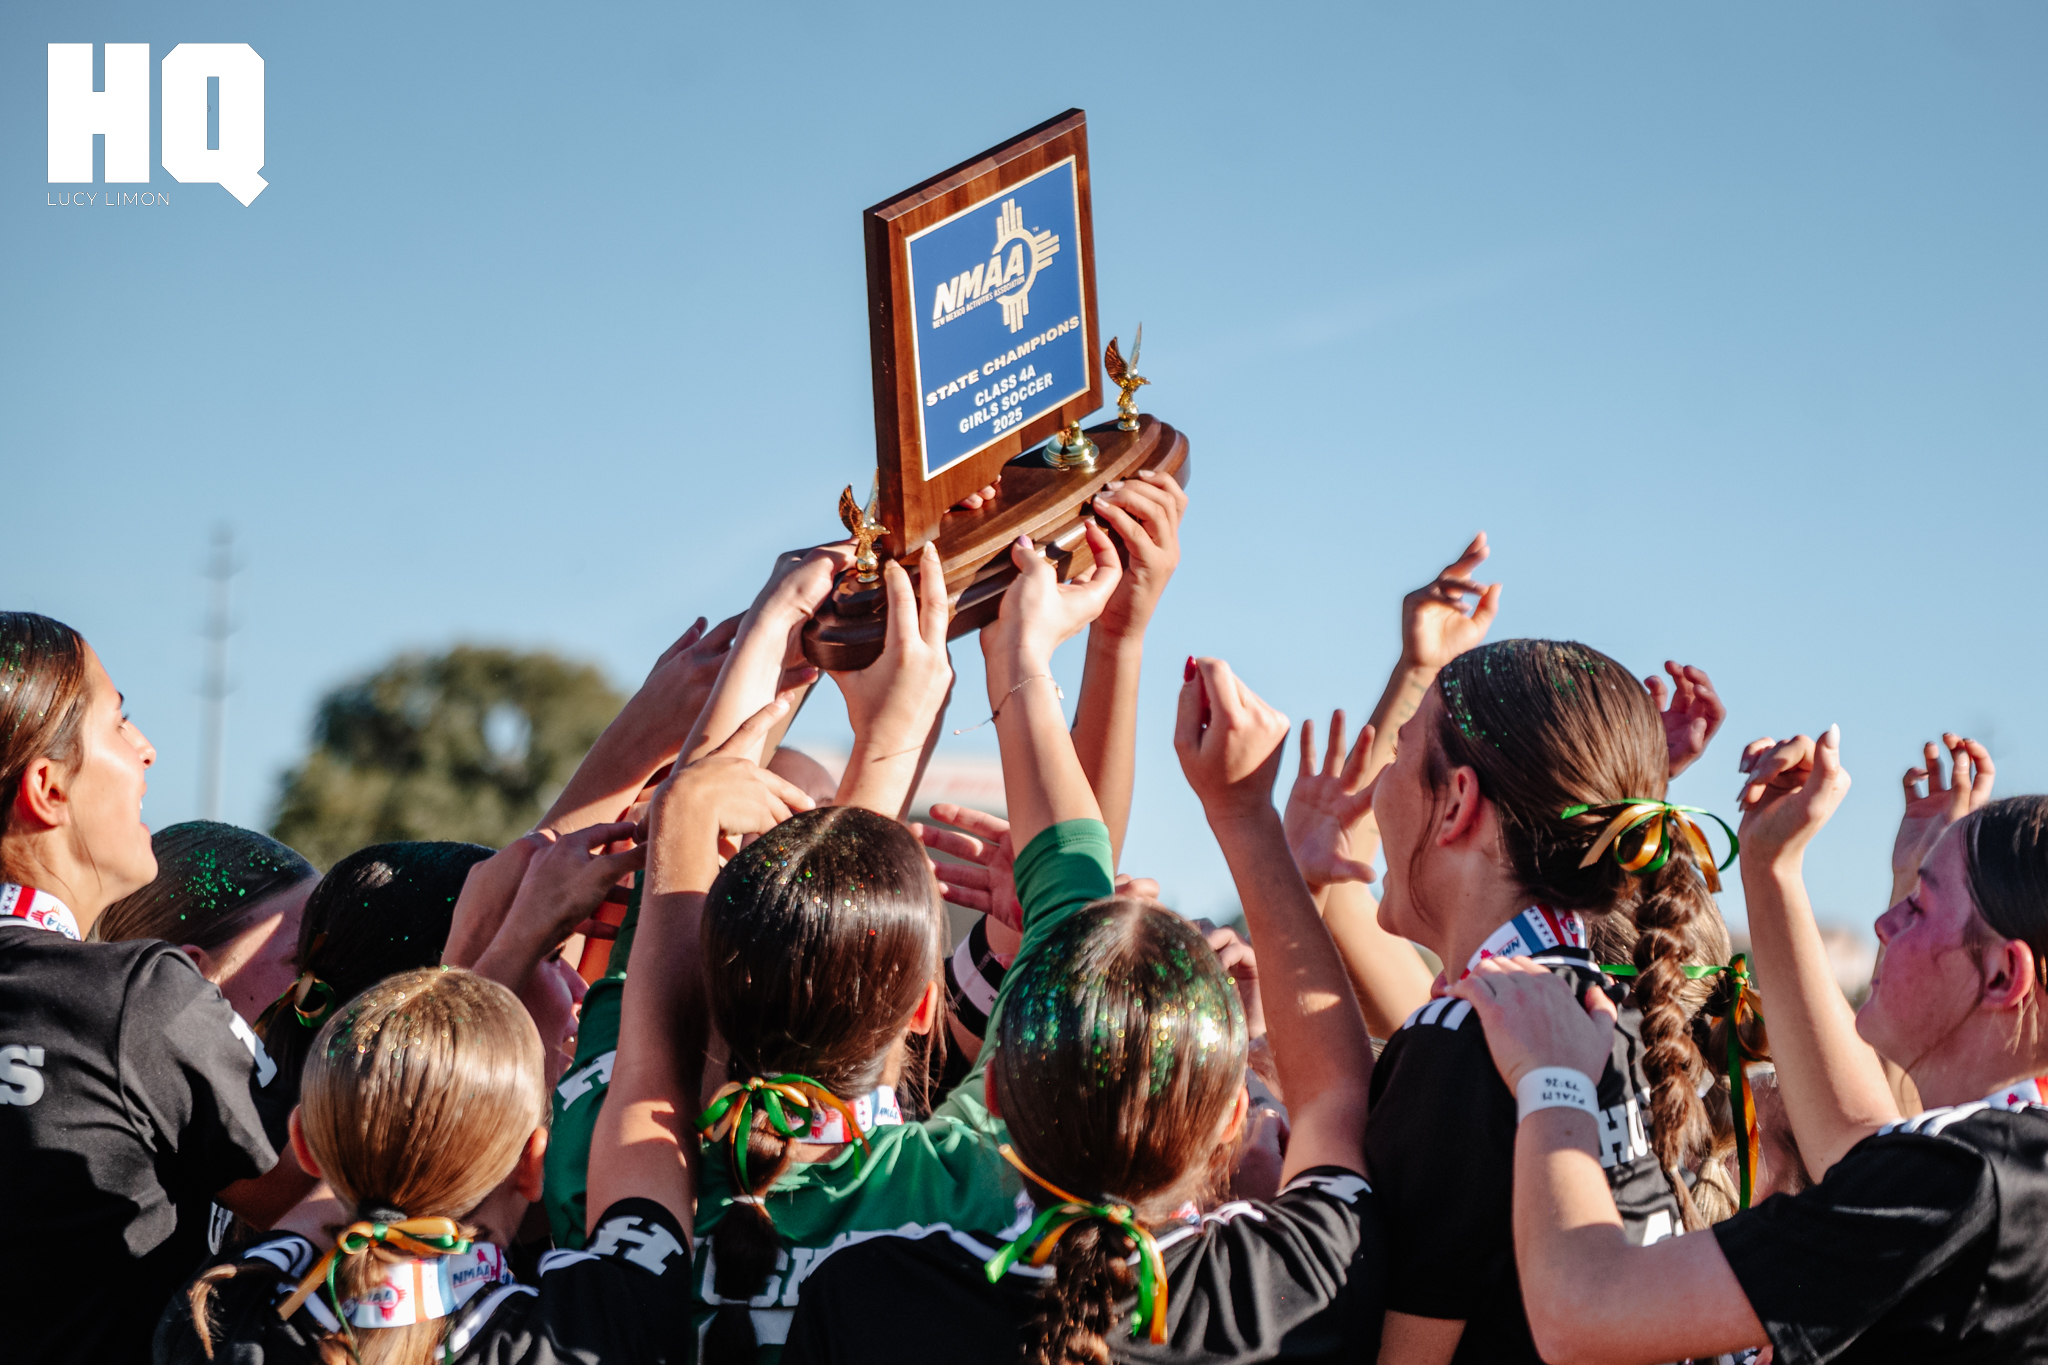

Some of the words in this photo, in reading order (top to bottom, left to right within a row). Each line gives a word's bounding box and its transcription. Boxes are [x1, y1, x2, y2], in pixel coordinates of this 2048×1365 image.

[932, 243, 1025, 320] NMAA
[932, 317, 946, 330] NEW
[945, 306, 966, 323] MEXICO
[966, 292, 994, 312] ACTIVITIES
[994, 275, 1025, 298] ASSOCIATION
[926, 369, 980, 407] STATE
[982, 316, 1080, 376] CHAMPIONS
[974, 374, 1018, 407] CLASS
[1019, 364, 1037, 383] 4A
[959, 402, 999, 434] GIRLS
[1001, 373, 1054, 411] SOCCER
[992, 407, 1024, 435] 2025
[453, 1264, 491, 1285] NMAA
